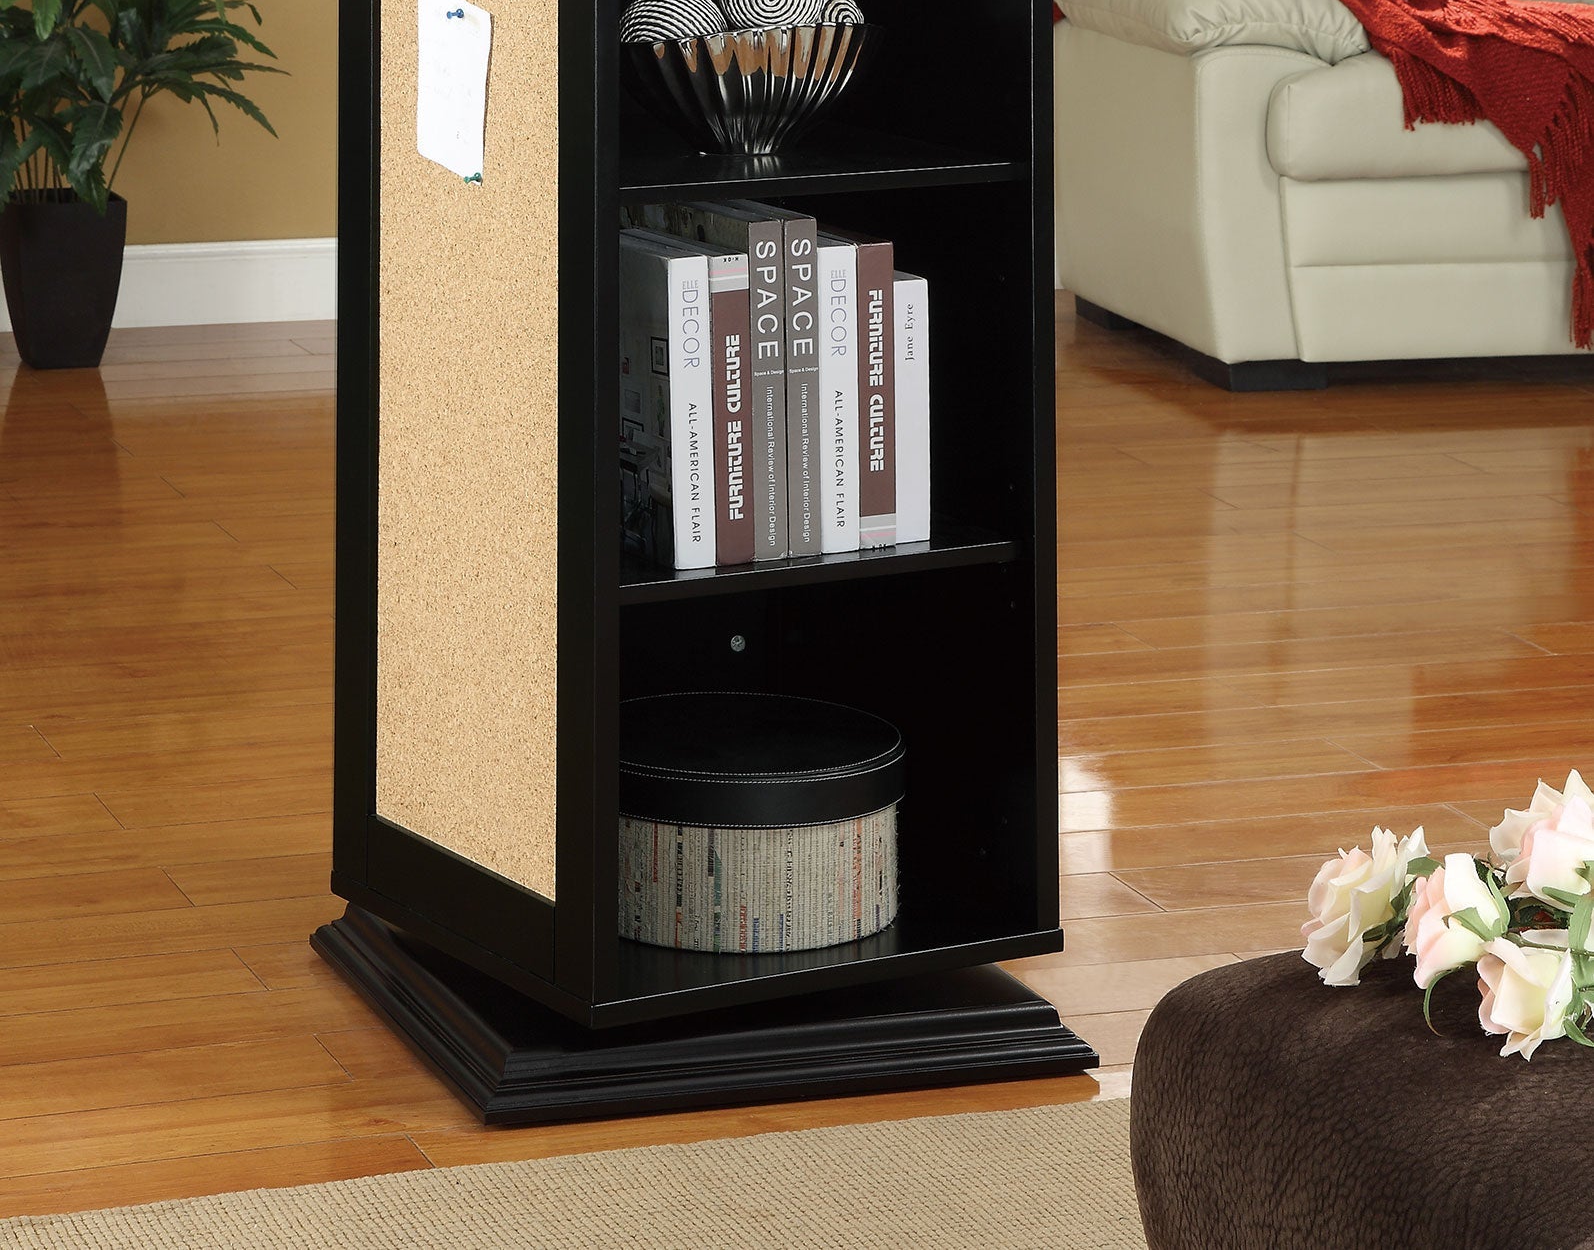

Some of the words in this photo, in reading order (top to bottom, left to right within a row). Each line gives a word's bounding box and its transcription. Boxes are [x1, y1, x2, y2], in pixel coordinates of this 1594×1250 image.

[682, 279, 699, 289] ELLE
[830, 269, 847, 279] ELLE
[756, 241, 779, 359] SPACE
[791, 238, 813, 357] SPACE
[682, 289, 701, 369] DECOR
[830, 279, 848, 357] DECOR
[904, 303, 916, 330] Eyre
[904, 336, 915, 361] Jane
[725, 334, 741, 413] CULTURE
[766, 386, 775, 439] International
[801, 383, 809, 436] International
[834, 390, 845, 486] ALL-AMERICAN
[868, 394, 884, 472] CULTURE
[688, 402, 700, 501] ALL-AMERICAN
[767, 441, 776, 472] Review
[802, 437, 810, 468] Review
[768, 473, 776, 482] of
[802, 468, 810, 479] of
[768, 484, 777, 513] Interior
[802, 480, 811, 510] Interior
[836, 492, 846, 528] FLAIR
[691, 507, 702, 543] FLAIR
[768, 515, 777, 546] Design
[802, 512, 812, 543] Design
